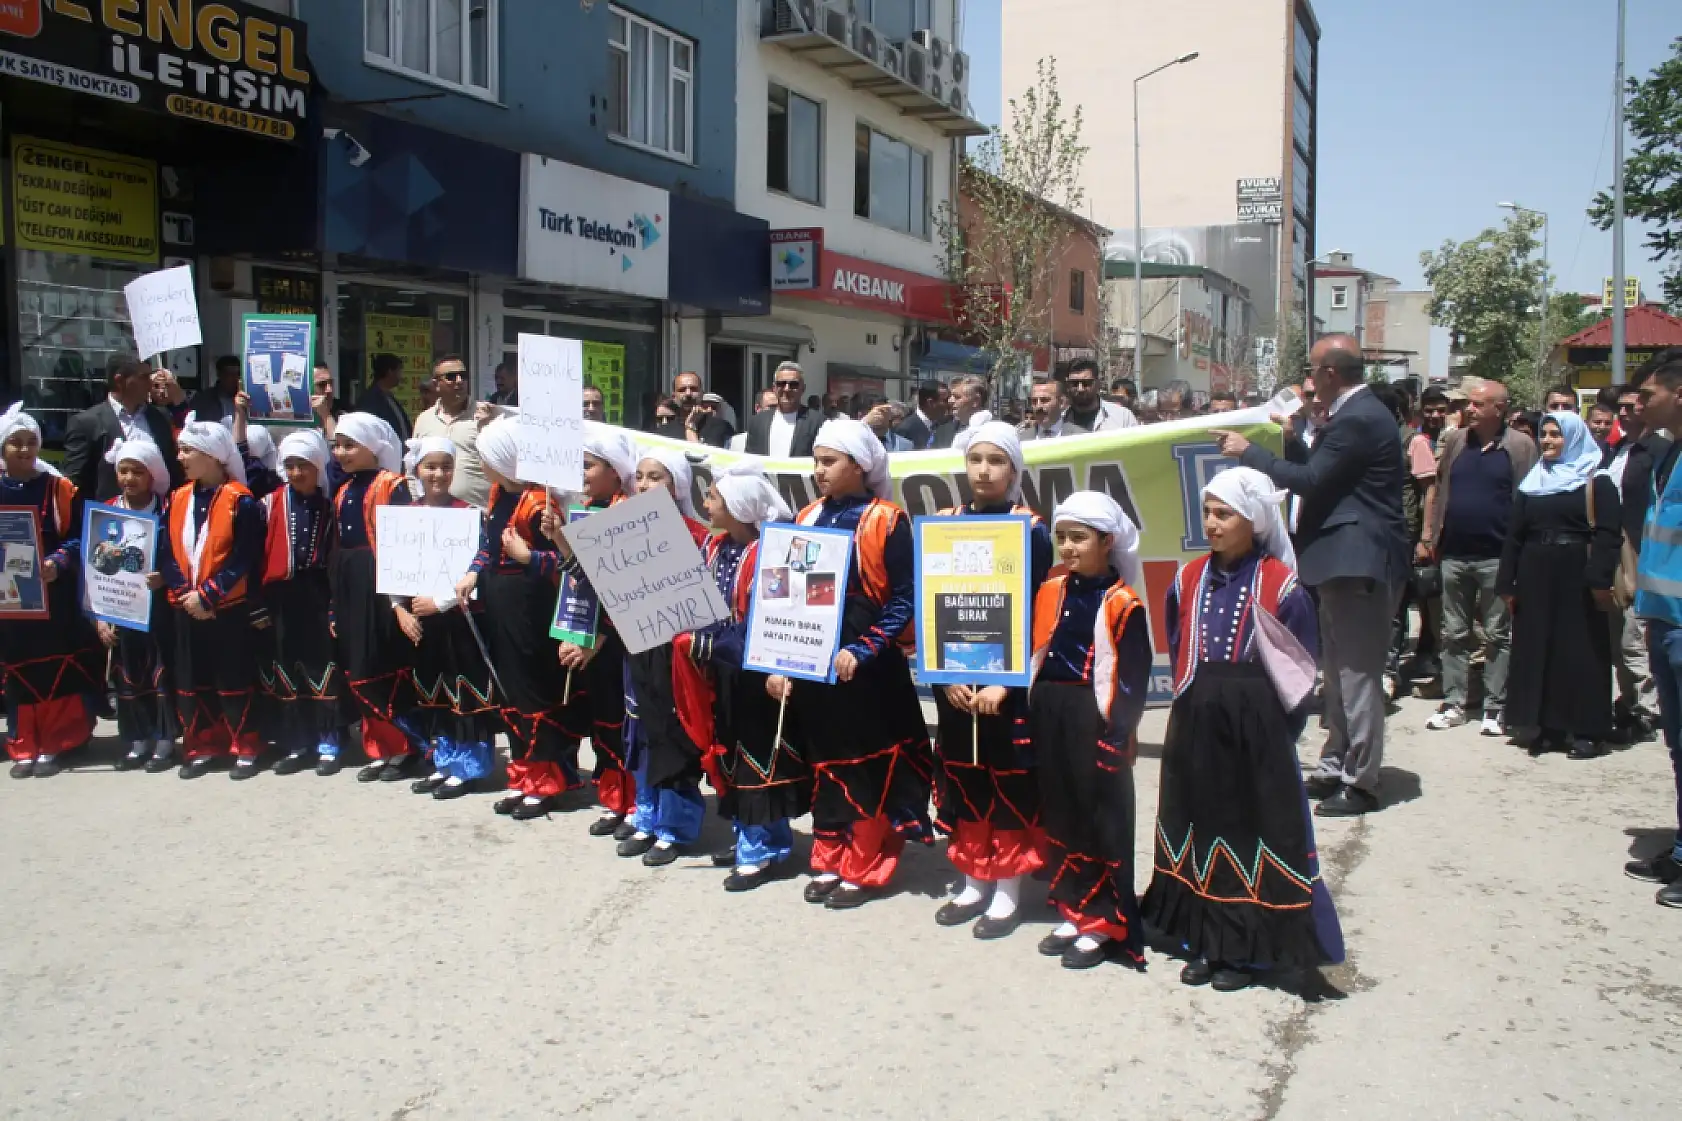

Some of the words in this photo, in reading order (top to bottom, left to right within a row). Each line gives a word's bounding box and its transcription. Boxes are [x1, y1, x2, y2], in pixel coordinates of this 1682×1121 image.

[20, 60, 65, 86] SATIŞ
[69, 71, 133, 99] NOKTASI
[112, 34, 306, 118] İLETİŞİM
[174, 98, 214, 122] 0544
[252, 116, 267, 131] 77
[22, 148, 93, 176] ZENGEL
[539, 207, 573, 235] Türk
[577, 216, 636, 249] Telekom
[833, 268, 904, 303] AKBANK
[596, 538, 672, 579] Alkole
[945, 594, 1004, 608] BAĞIMLILIĞI
[958, 609, 988, 622] BIRAK
